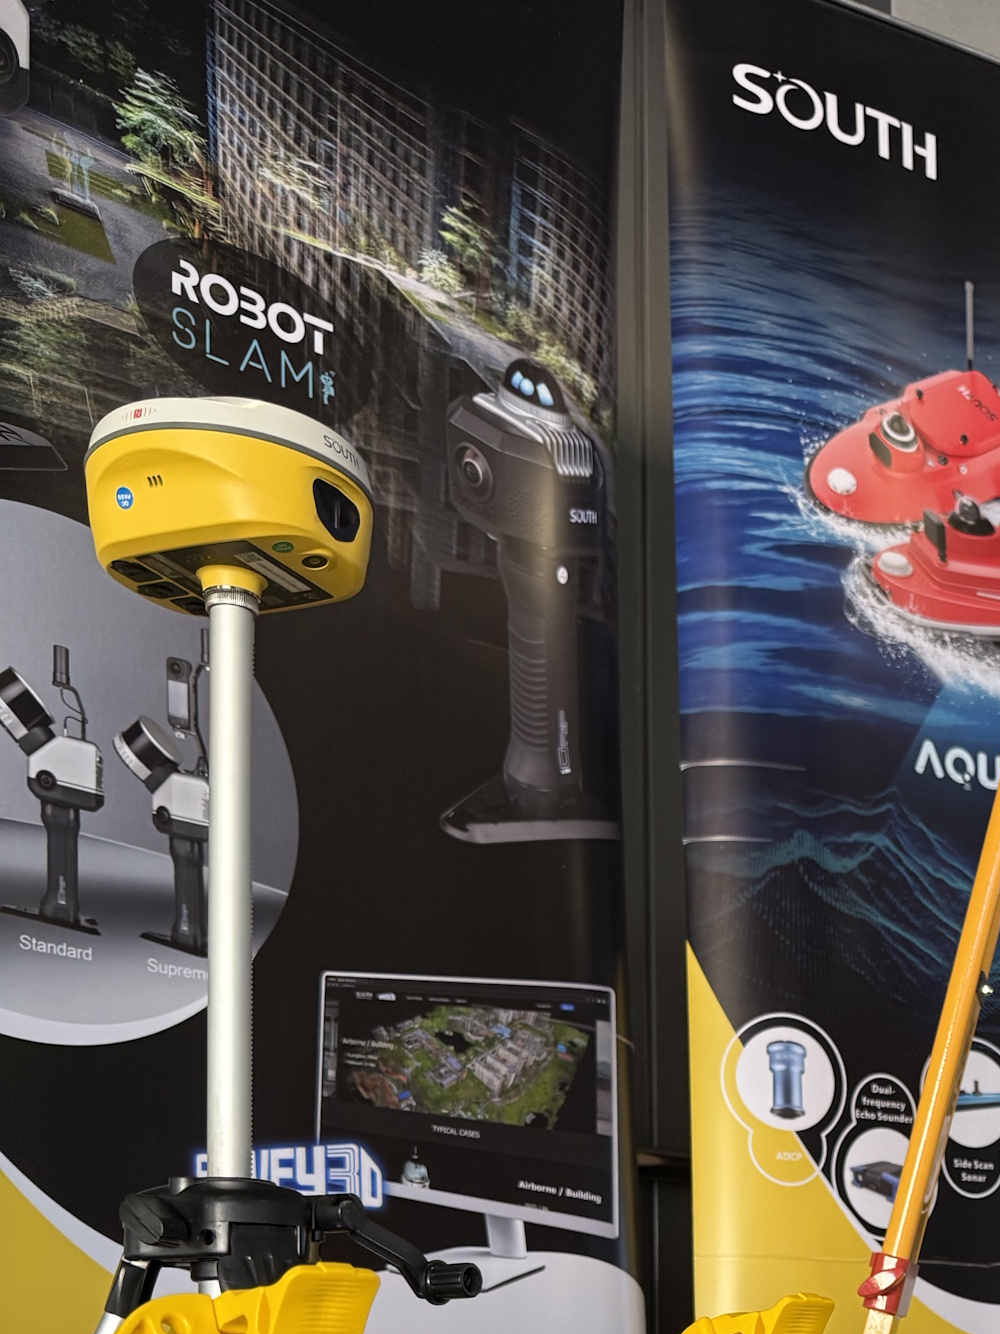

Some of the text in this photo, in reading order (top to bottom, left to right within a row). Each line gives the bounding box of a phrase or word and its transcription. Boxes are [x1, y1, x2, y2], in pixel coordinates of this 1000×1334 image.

[732, 63, 937, 180] SOUTH
[172, 259, 334, 355] ROBOT
[172, 307, 313, 399] SLAM
[323, 434, 360, 470] SOUTH
[569, 508, 598, 525] SOUTH
[19, 934, 93, 961] Standard
[147, 958, 208, 981] Suprem
[870, 1083, 895, 1095] Dual-
[861, 1096, 906, 1112] frequency
[855, 1110, 913, 1124] Echo Sounder
[432, 1124, 481, 1140] TYPICAL CASES
[776, 1151, 803, 1161] ADCP
[953, 1157, 995, 1171] Side Scan
[961, 1172, 987, 1183] Sonar
[518, 1179, 557, 1195] Airborne
[565, 1187, 602, 1205] Building
